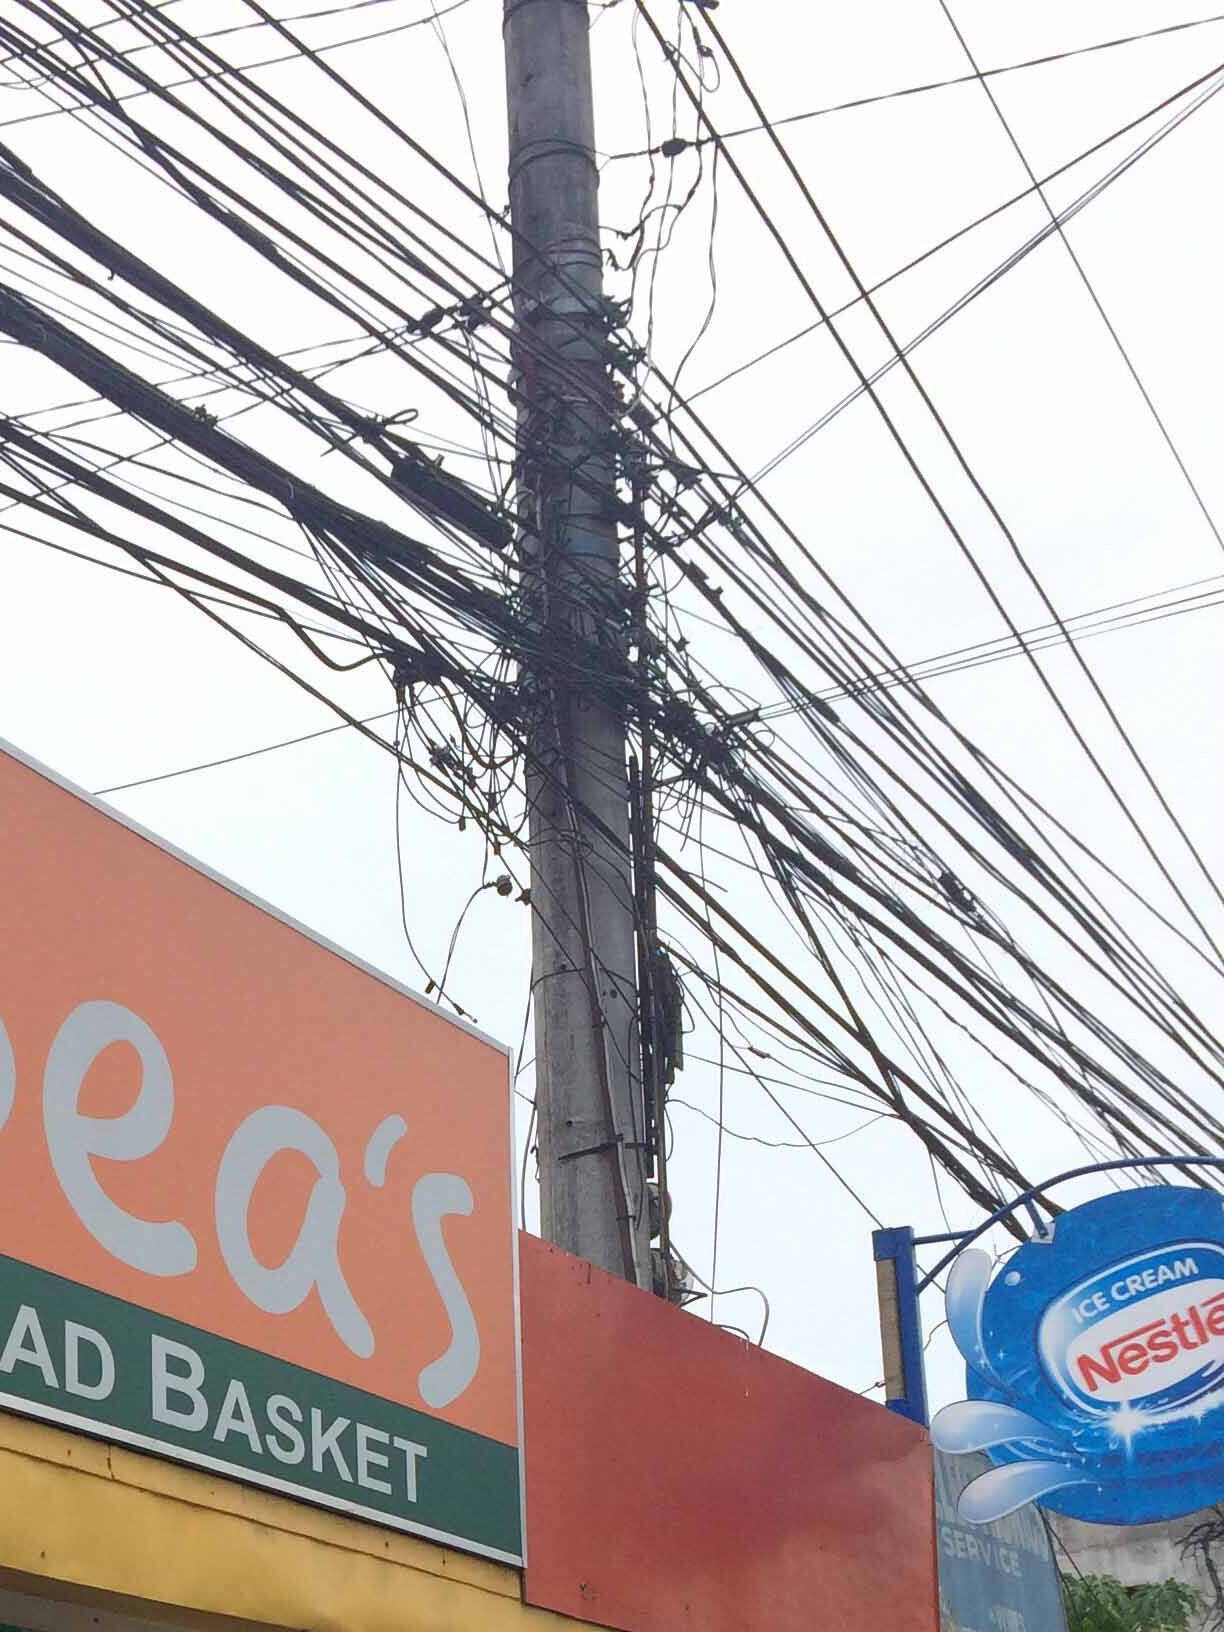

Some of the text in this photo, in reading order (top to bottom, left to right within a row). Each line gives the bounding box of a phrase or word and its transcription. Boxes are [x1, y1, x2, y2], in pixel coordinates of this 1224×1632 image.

[1072, 1258, 1199, 1324] ICE CREAM
[150, 1333, 429, 1504] BASKET
[941, 1526, 1022, 1577] SERVICE
